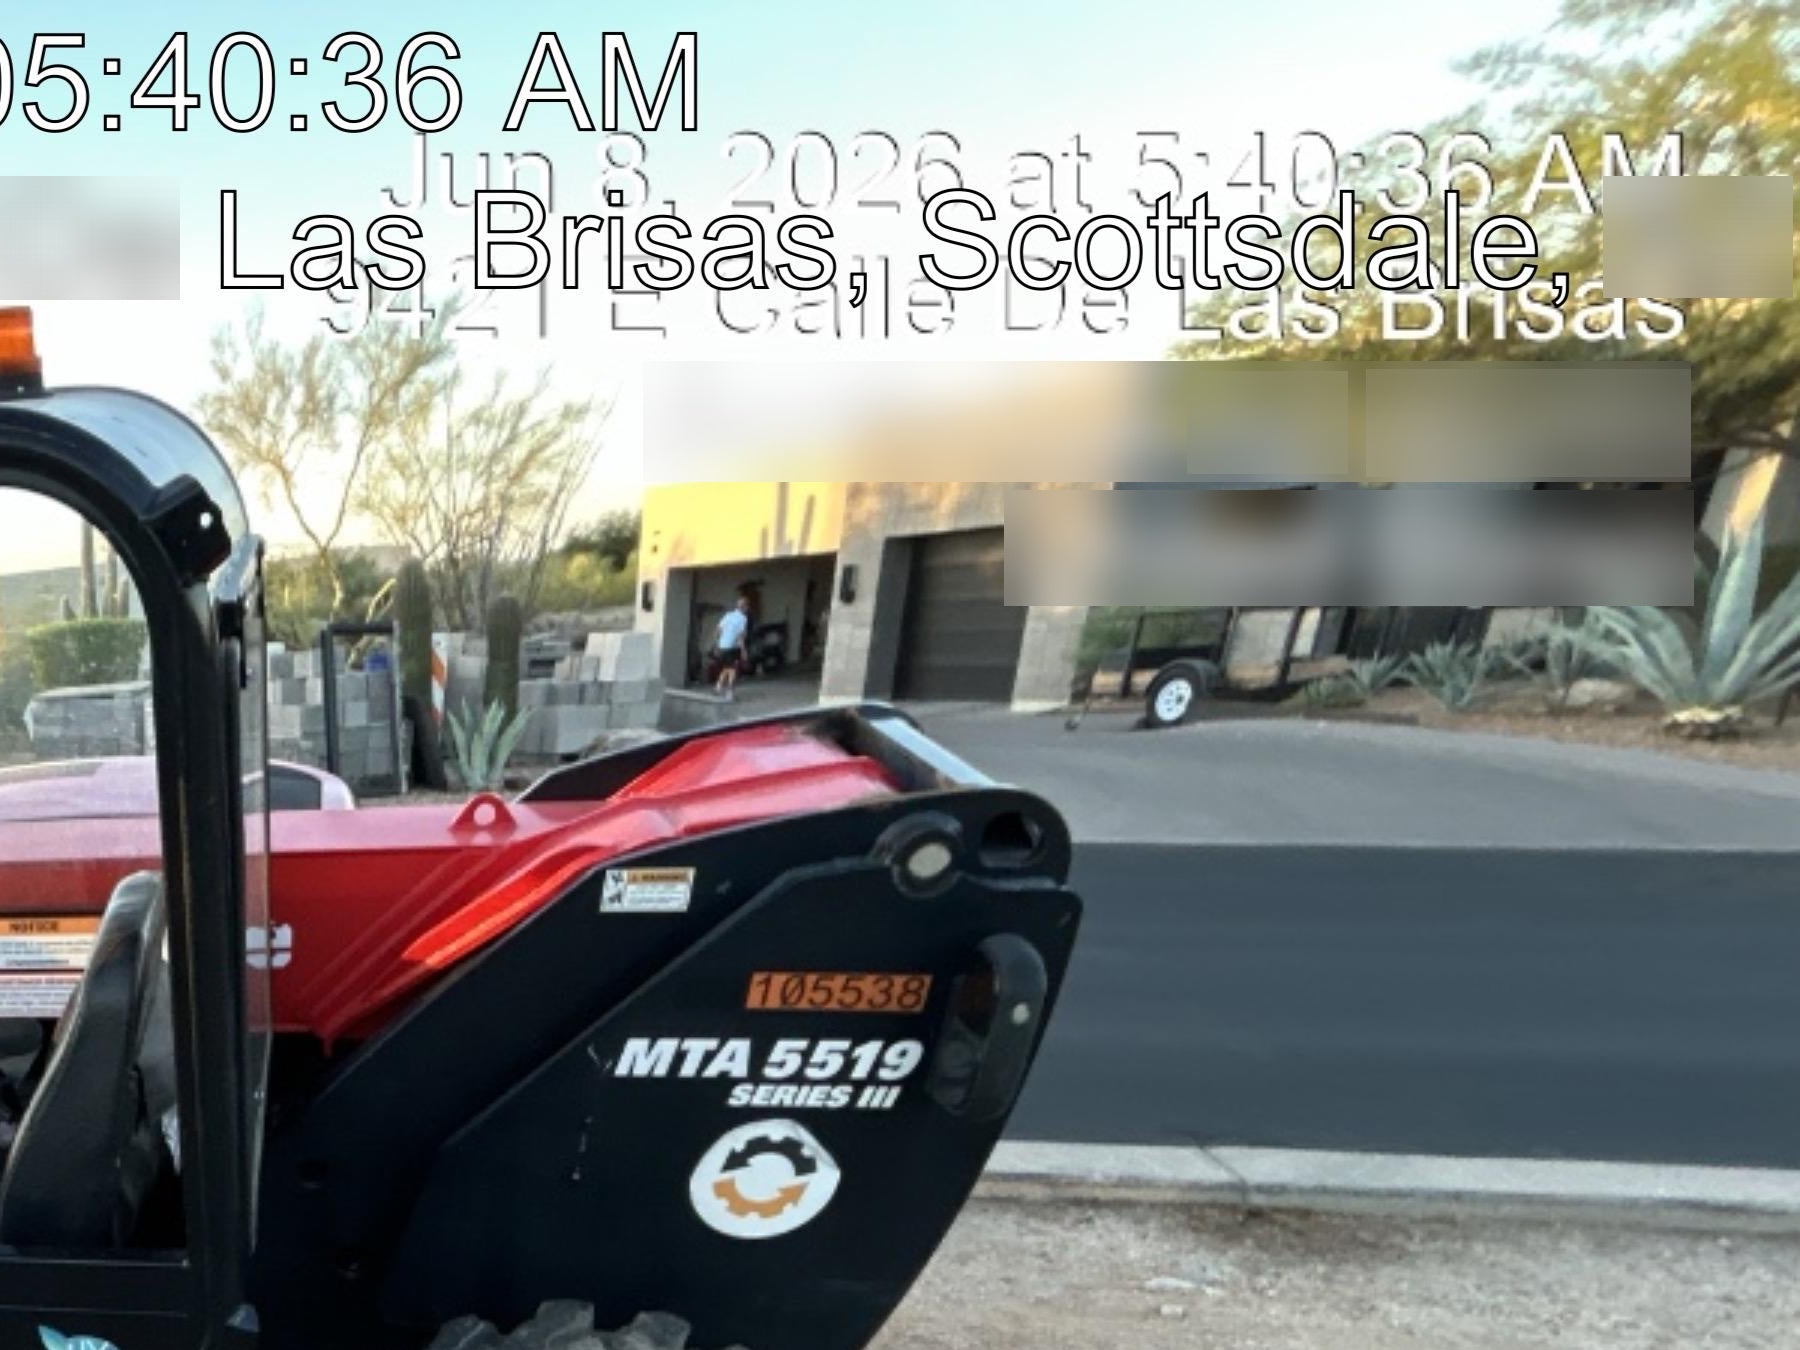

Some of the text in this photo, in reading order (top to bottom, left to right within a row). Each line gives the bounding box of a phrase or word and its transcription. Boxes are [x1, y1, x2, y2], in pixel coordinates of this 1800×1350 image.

[755, 974, 925, 1010] 105538
[614, 1038, 924, 1080] MTA 5519
[728, 1083, 901, 1108] SERIES III
